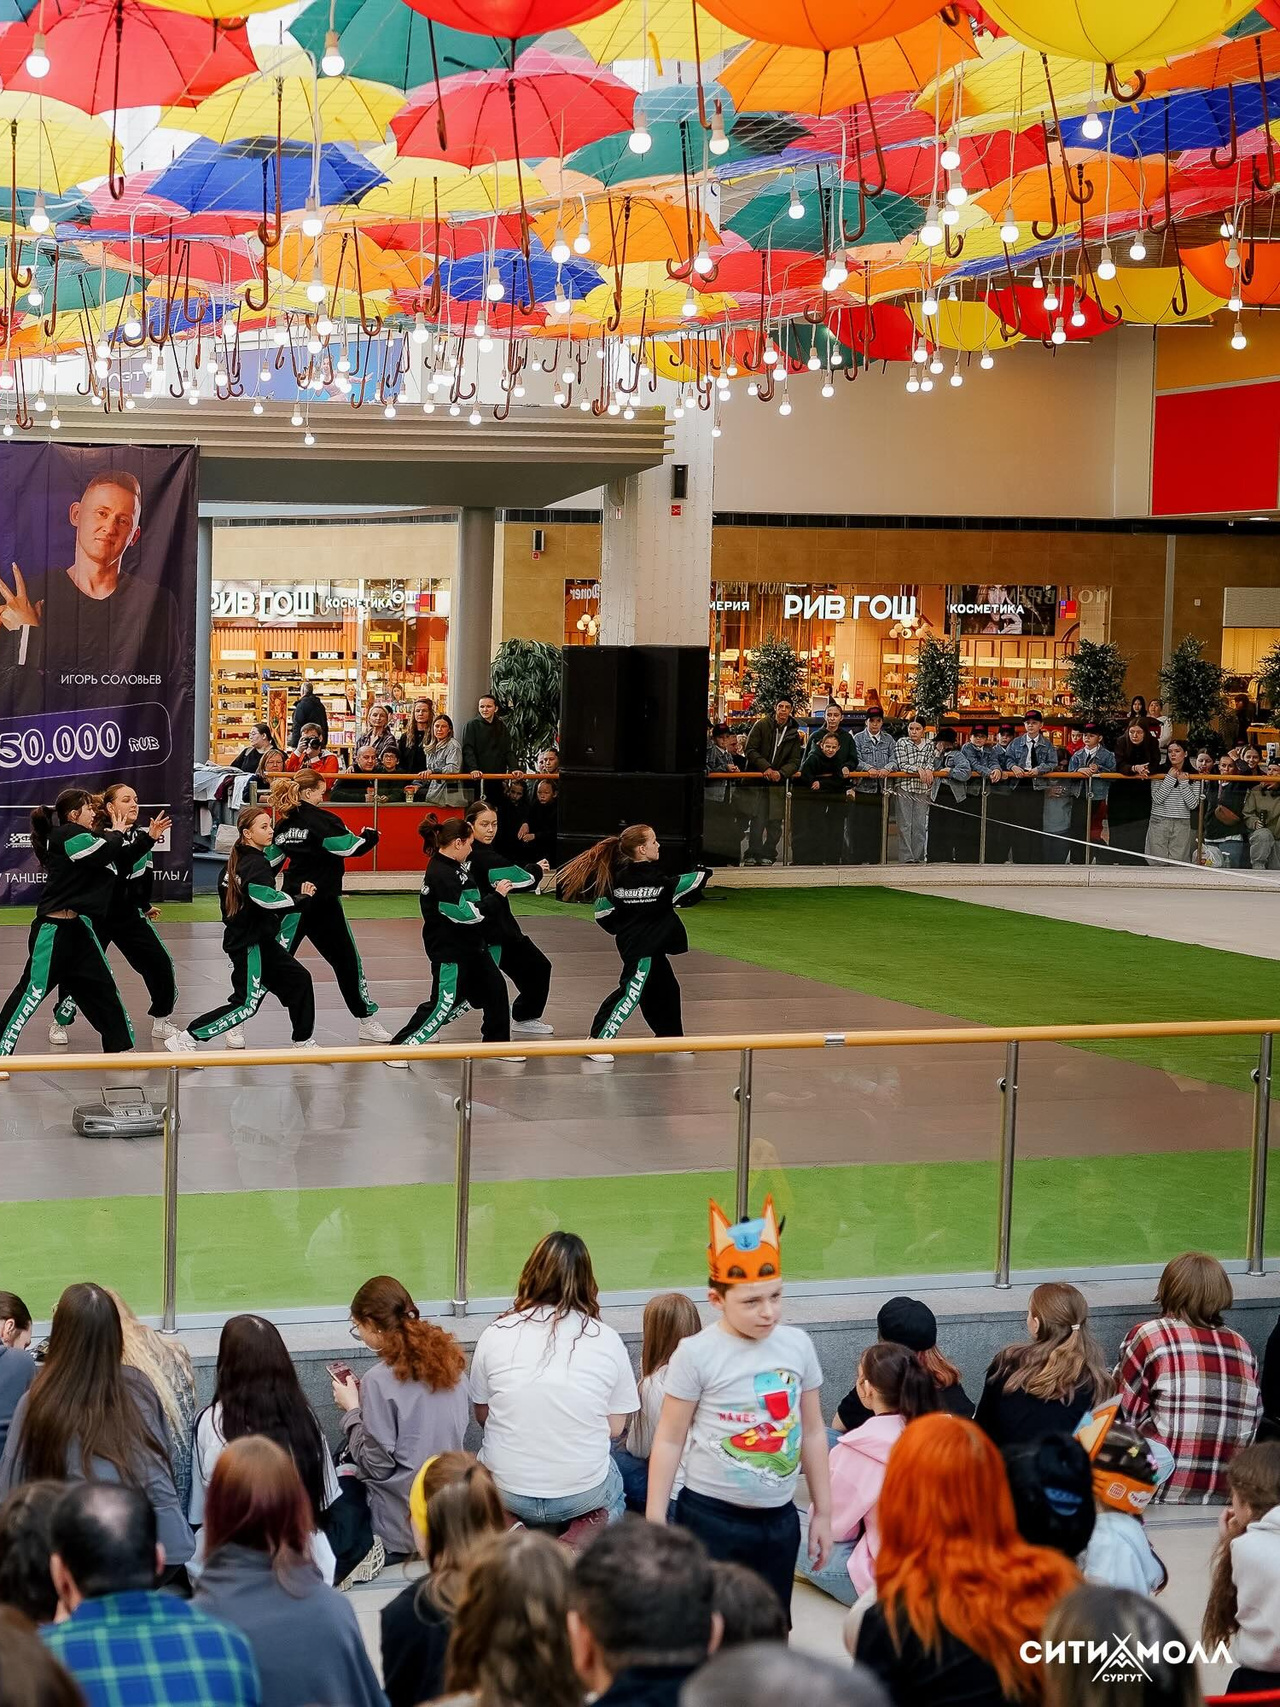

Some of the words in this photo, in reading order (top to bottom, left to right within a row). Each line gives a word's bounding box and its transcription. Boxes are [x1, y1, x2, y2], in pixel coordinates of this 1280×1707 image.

[258, 591, 318, 616] ГОШ
[325, 597, 393, 609] КОСМЕТИКА
[784, 594, 846, 620] РИВ
[853, 595, 916, 620] ГОШ
[949, 603, 1025, 614] КОСМЕТИКА
[271, 651, 293, 660] DIOR
[317, 651, 339, 660] DIOR
[60, 674, 98, 685] ИГОРЬ
[101, 674, 162, 686] СОЛОВЬЕВ
[128, 736, 160, 753] RUB
